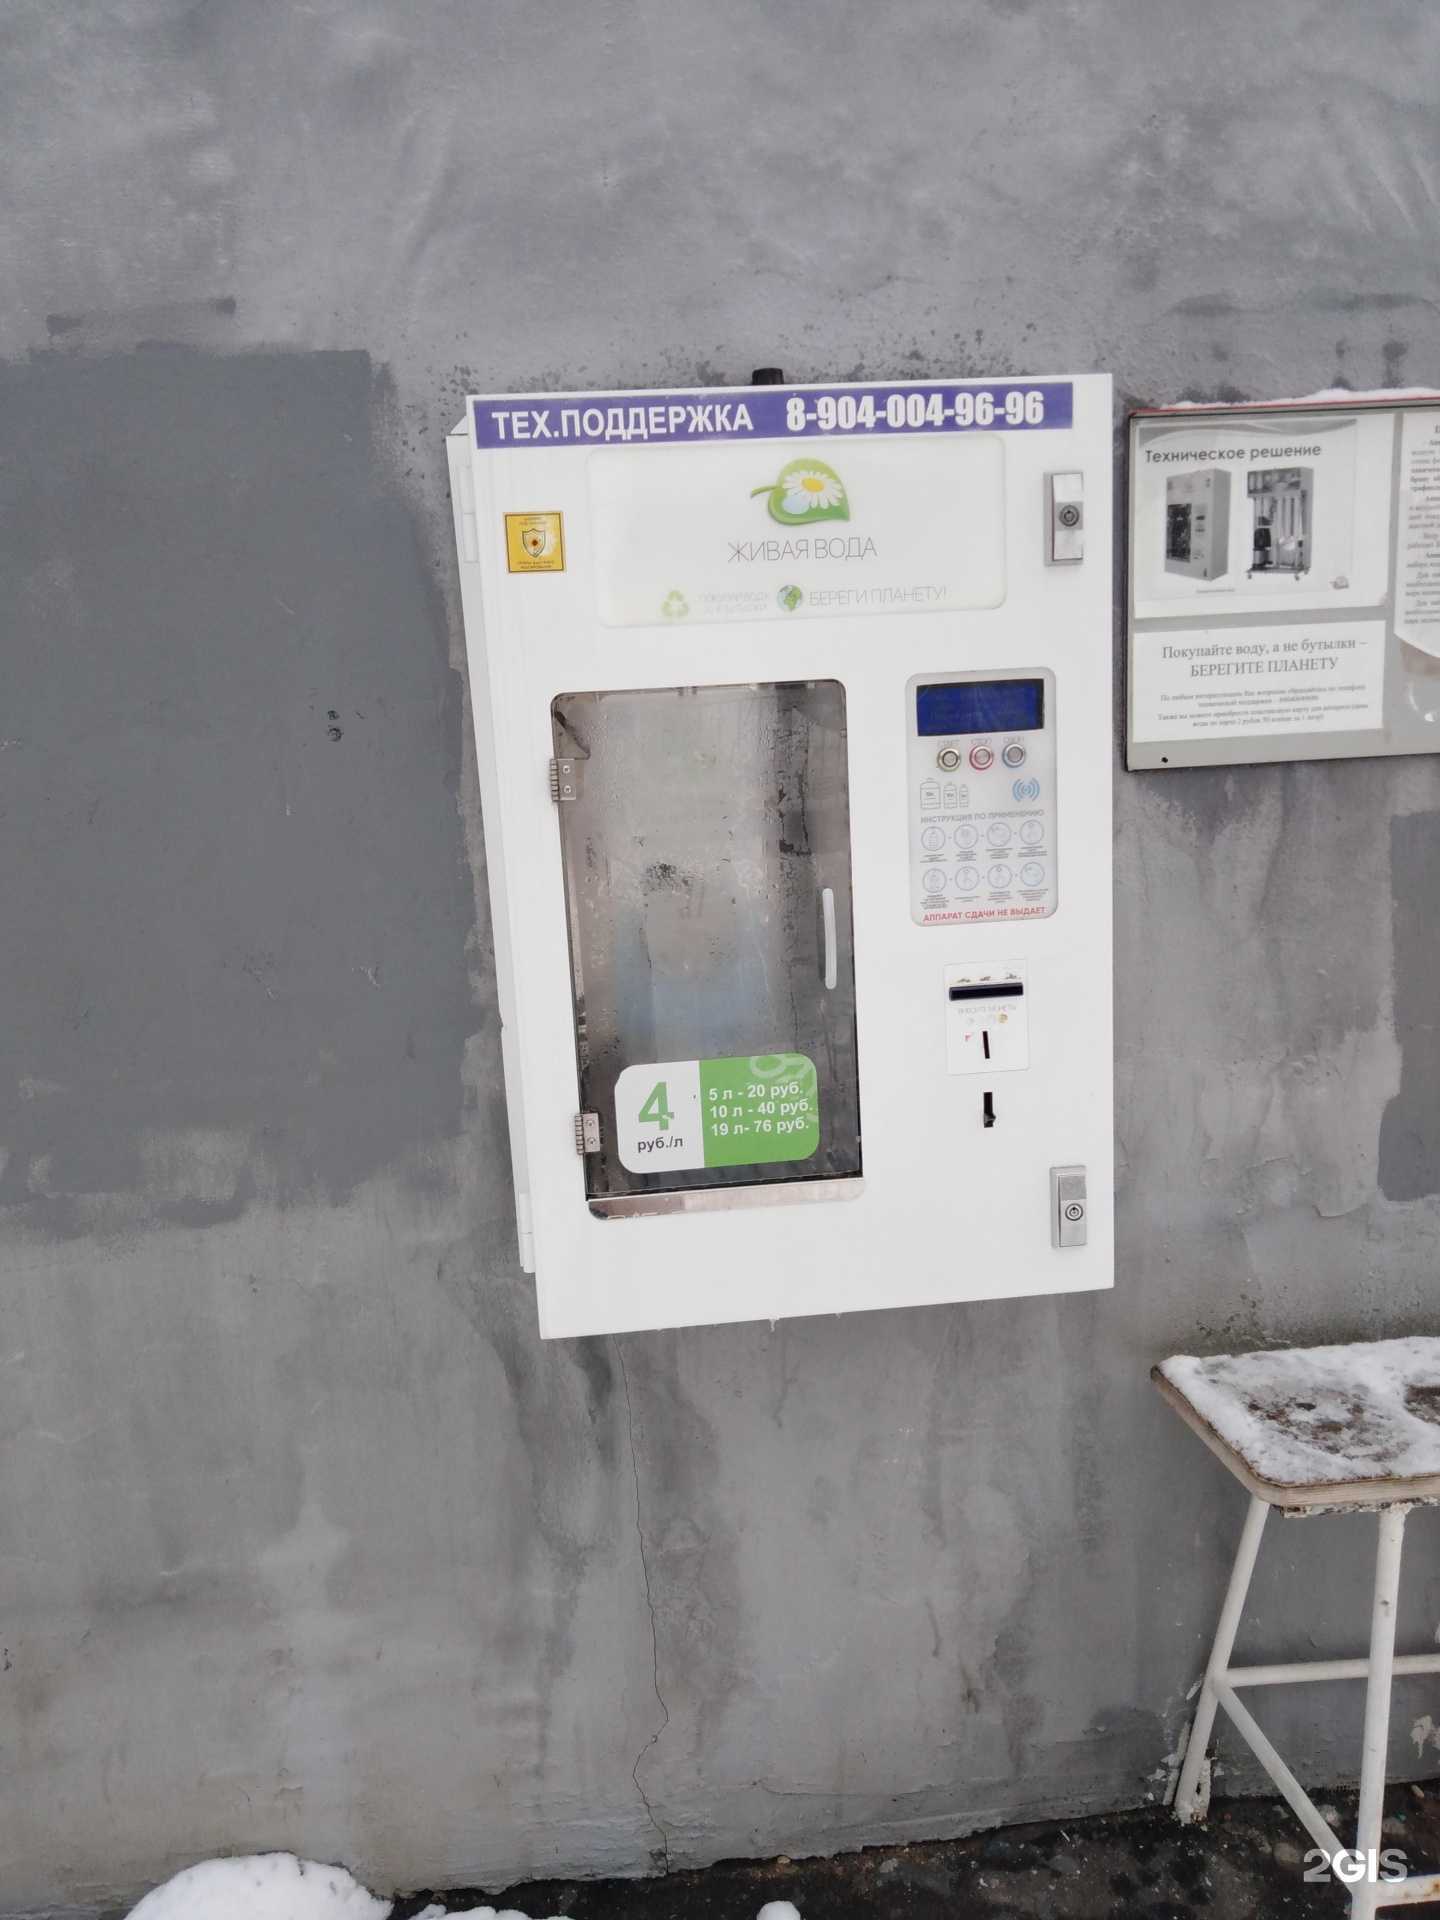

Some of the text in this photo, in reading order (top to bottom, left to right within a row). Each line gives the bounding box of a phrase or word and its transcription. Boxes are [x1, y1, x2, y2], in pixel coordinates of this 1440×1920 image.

[491, 391, 1045, 441] ТЕХ.ПОДДЕРЖКА 8-904-004-96-96
[1145, 445, 1322, 464] Техническое решение
[727, 536, 878, 562] ЖИВАЯ ВОДА
[809, 586, 947, 607] БЕРЕГИ ПЛАНЕТУ!
[1161, 645, 1233, 661] Покупайте
[1235, 645, 1271, 658] воду,
[1272, 643, 1280, 652] а
[1283, 642, 1299, 652] не
[1301, 638, 1357, 654] бутылки
[1190, 657, 1338, 677] БЕРЕГИТЕ ПЛАНЕТУ
[975, 811, 986, 820] ПО
[923, 906, 1045, 922] АППАРАТ СДАЧИ НЕ ВЫДАЕТ
[708, 1088, 718, 1101] 5
[722, 1090, 732, 1100] л
[747, 1085, 765, 1098] 20
[770, 1081, 804, 1099] руб.
[638, 1081, 675, 1131] 4
[710, 1105, 728, 1118] 10
[731, 1106, 743, 1117] л
[757, 1102, 776, 1115] 40
[780, 1098, 813, 1116] руб.
[711, 1123, 728, 1136] 19
[754, 1120, 772, 1133] 76
[776, 1116, 809, 1134] руб.
[637, 1136, 684, 1153] руб./л
